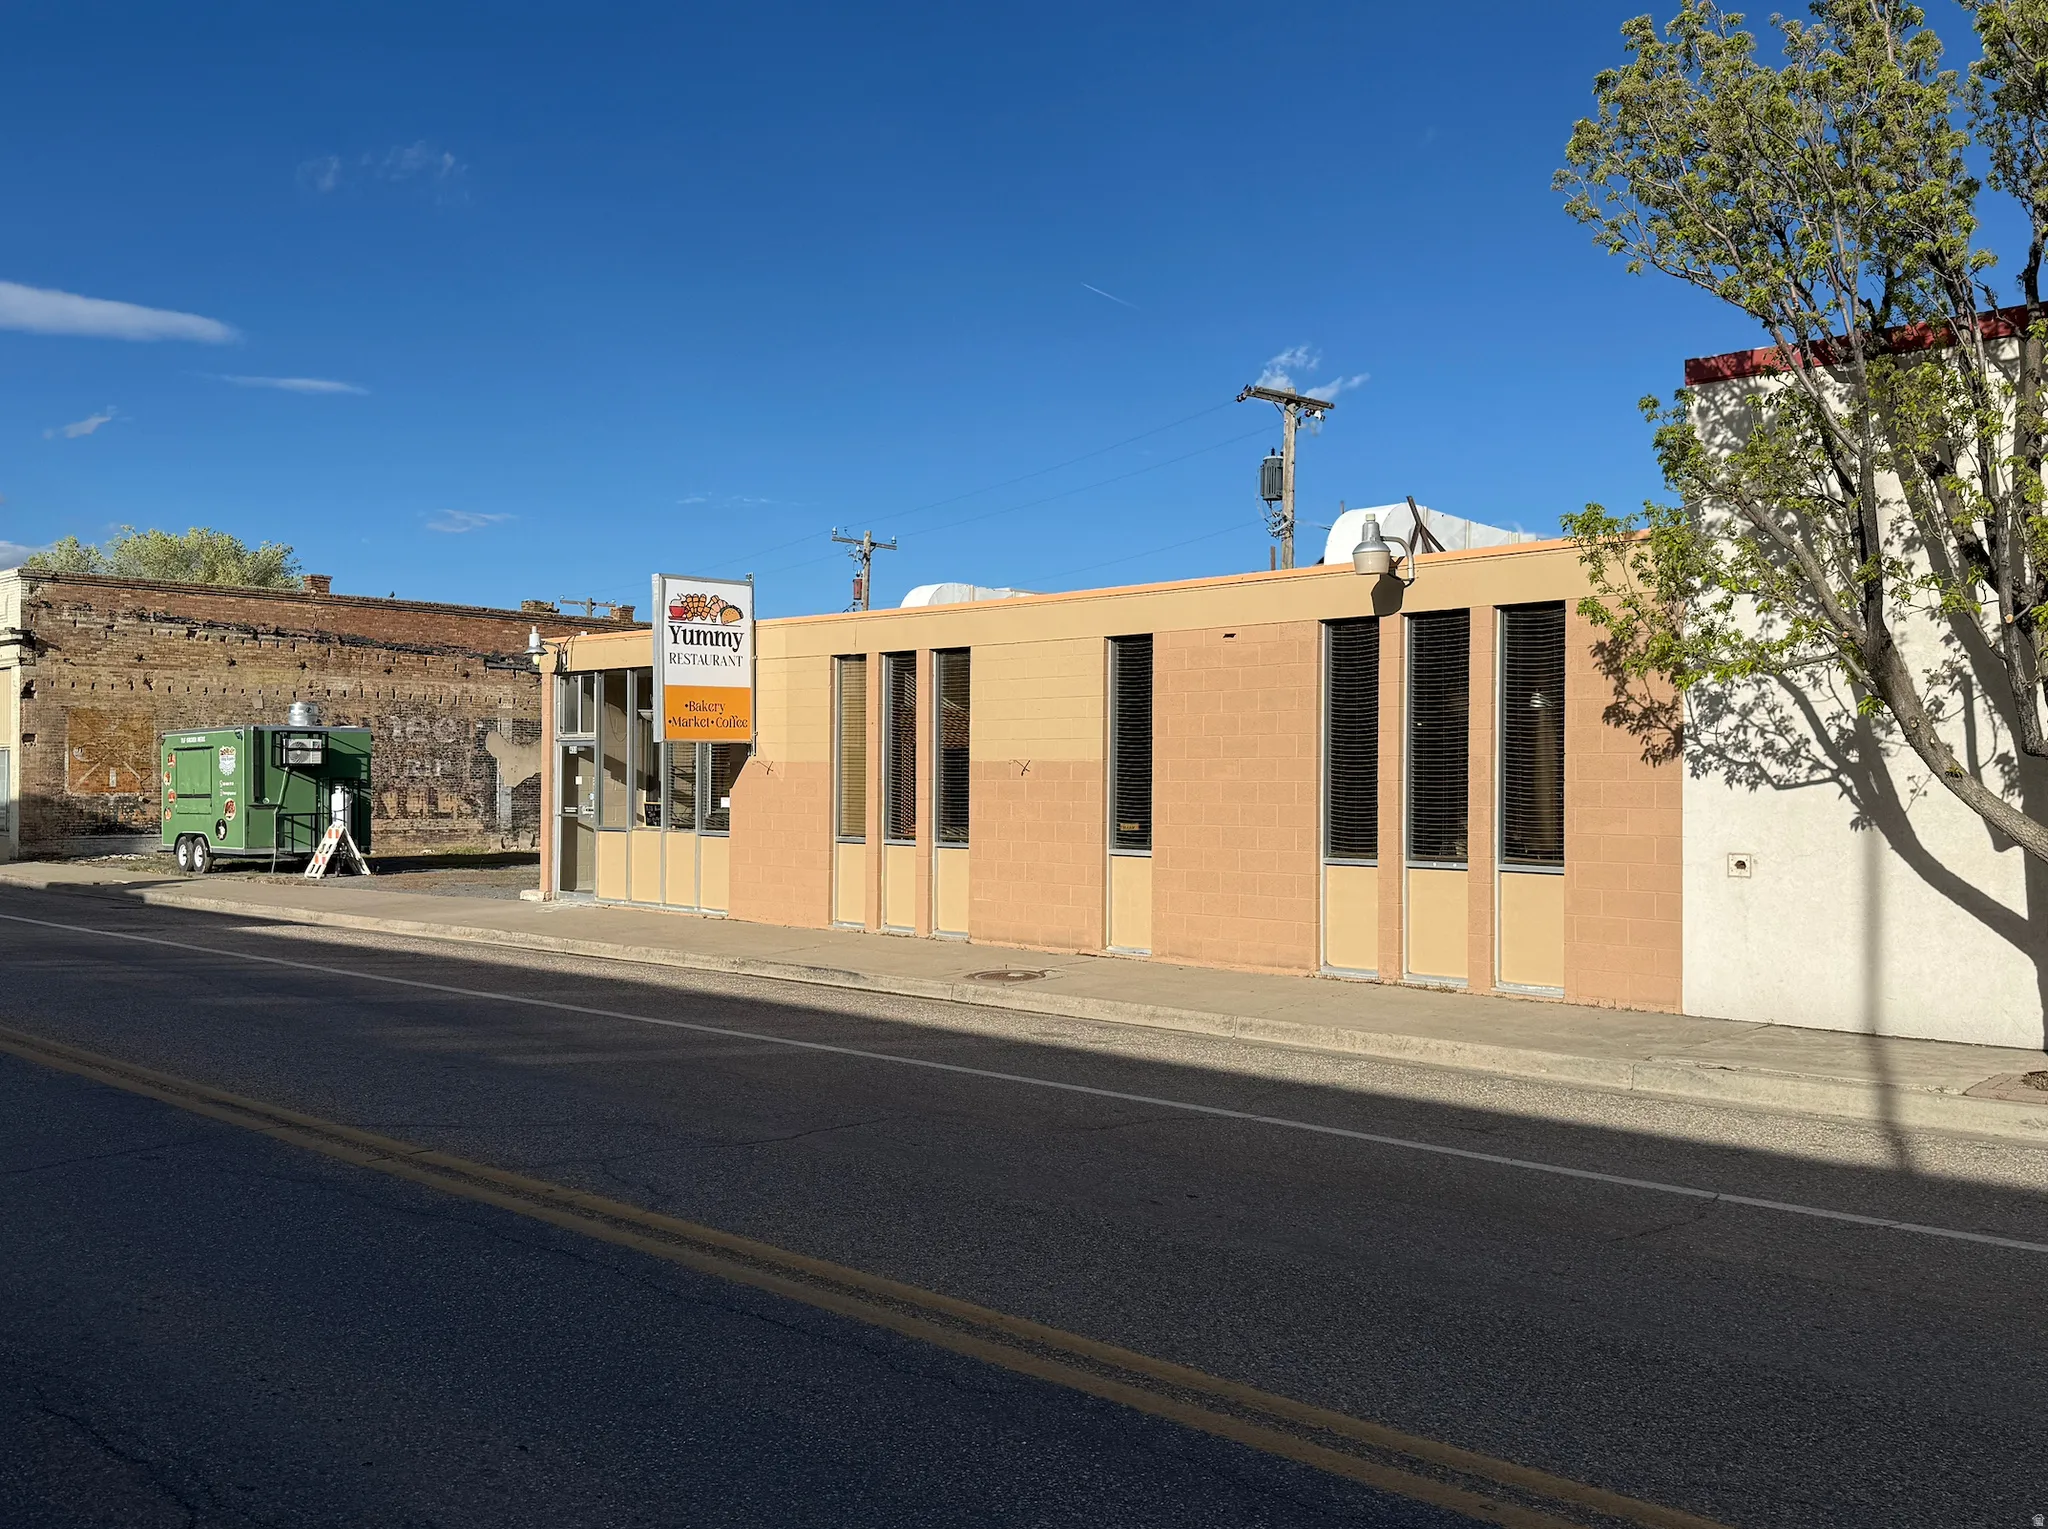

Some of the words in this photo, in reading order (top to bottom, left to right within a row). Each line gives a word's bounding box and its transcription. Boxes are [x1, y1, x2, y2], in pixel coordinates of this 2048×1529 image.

[669, 625, 744, 652] Yummy
[669, 652, 743, 667] RESTAURANT
[689, 700, 726, 715] Bakery
[672, 716, 710, 728] Market
[716, 715, 748, 728] Coffee
